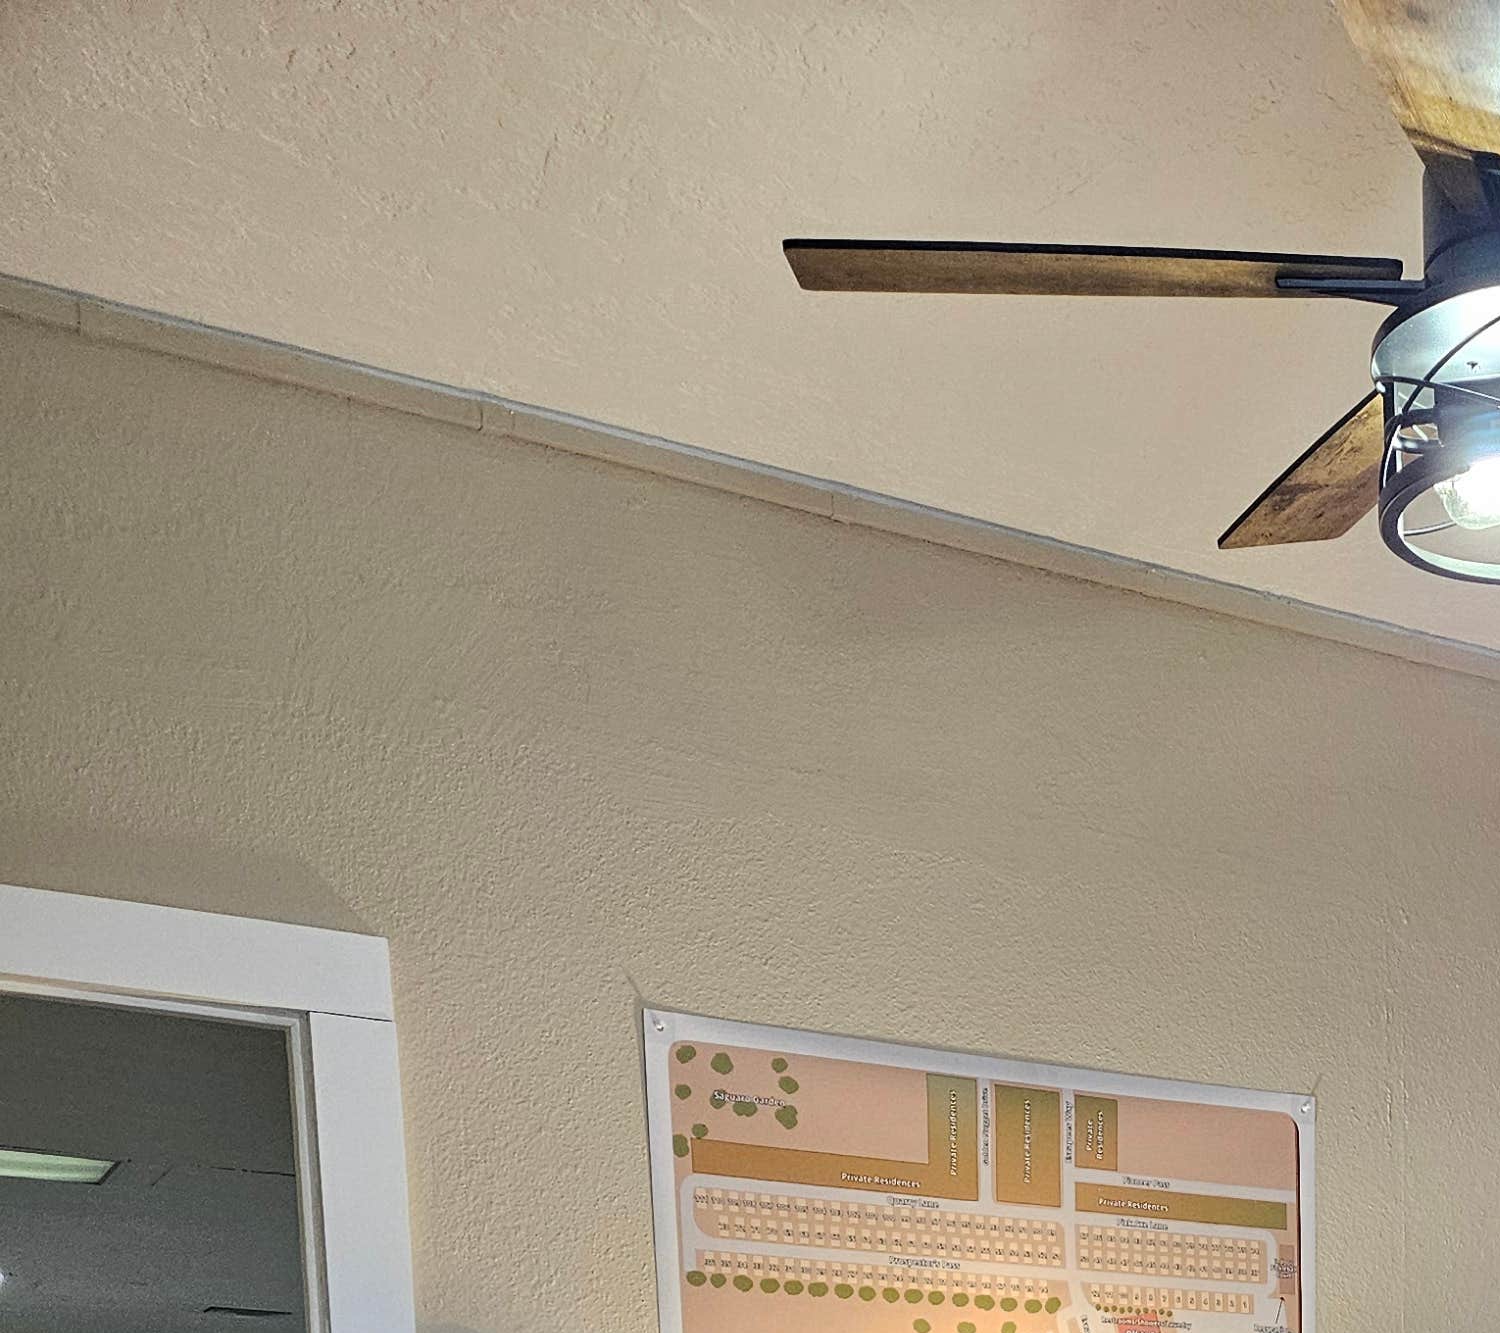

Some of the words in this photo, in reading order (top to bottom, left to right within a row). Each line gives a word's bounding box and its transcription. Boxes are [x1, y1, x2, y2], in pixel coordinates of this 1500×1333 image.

[841, 1172, 873, 1186] Private
[874, 1175, 921, 1188] Residences
[1098, 1197, 1126, 1208] Private
